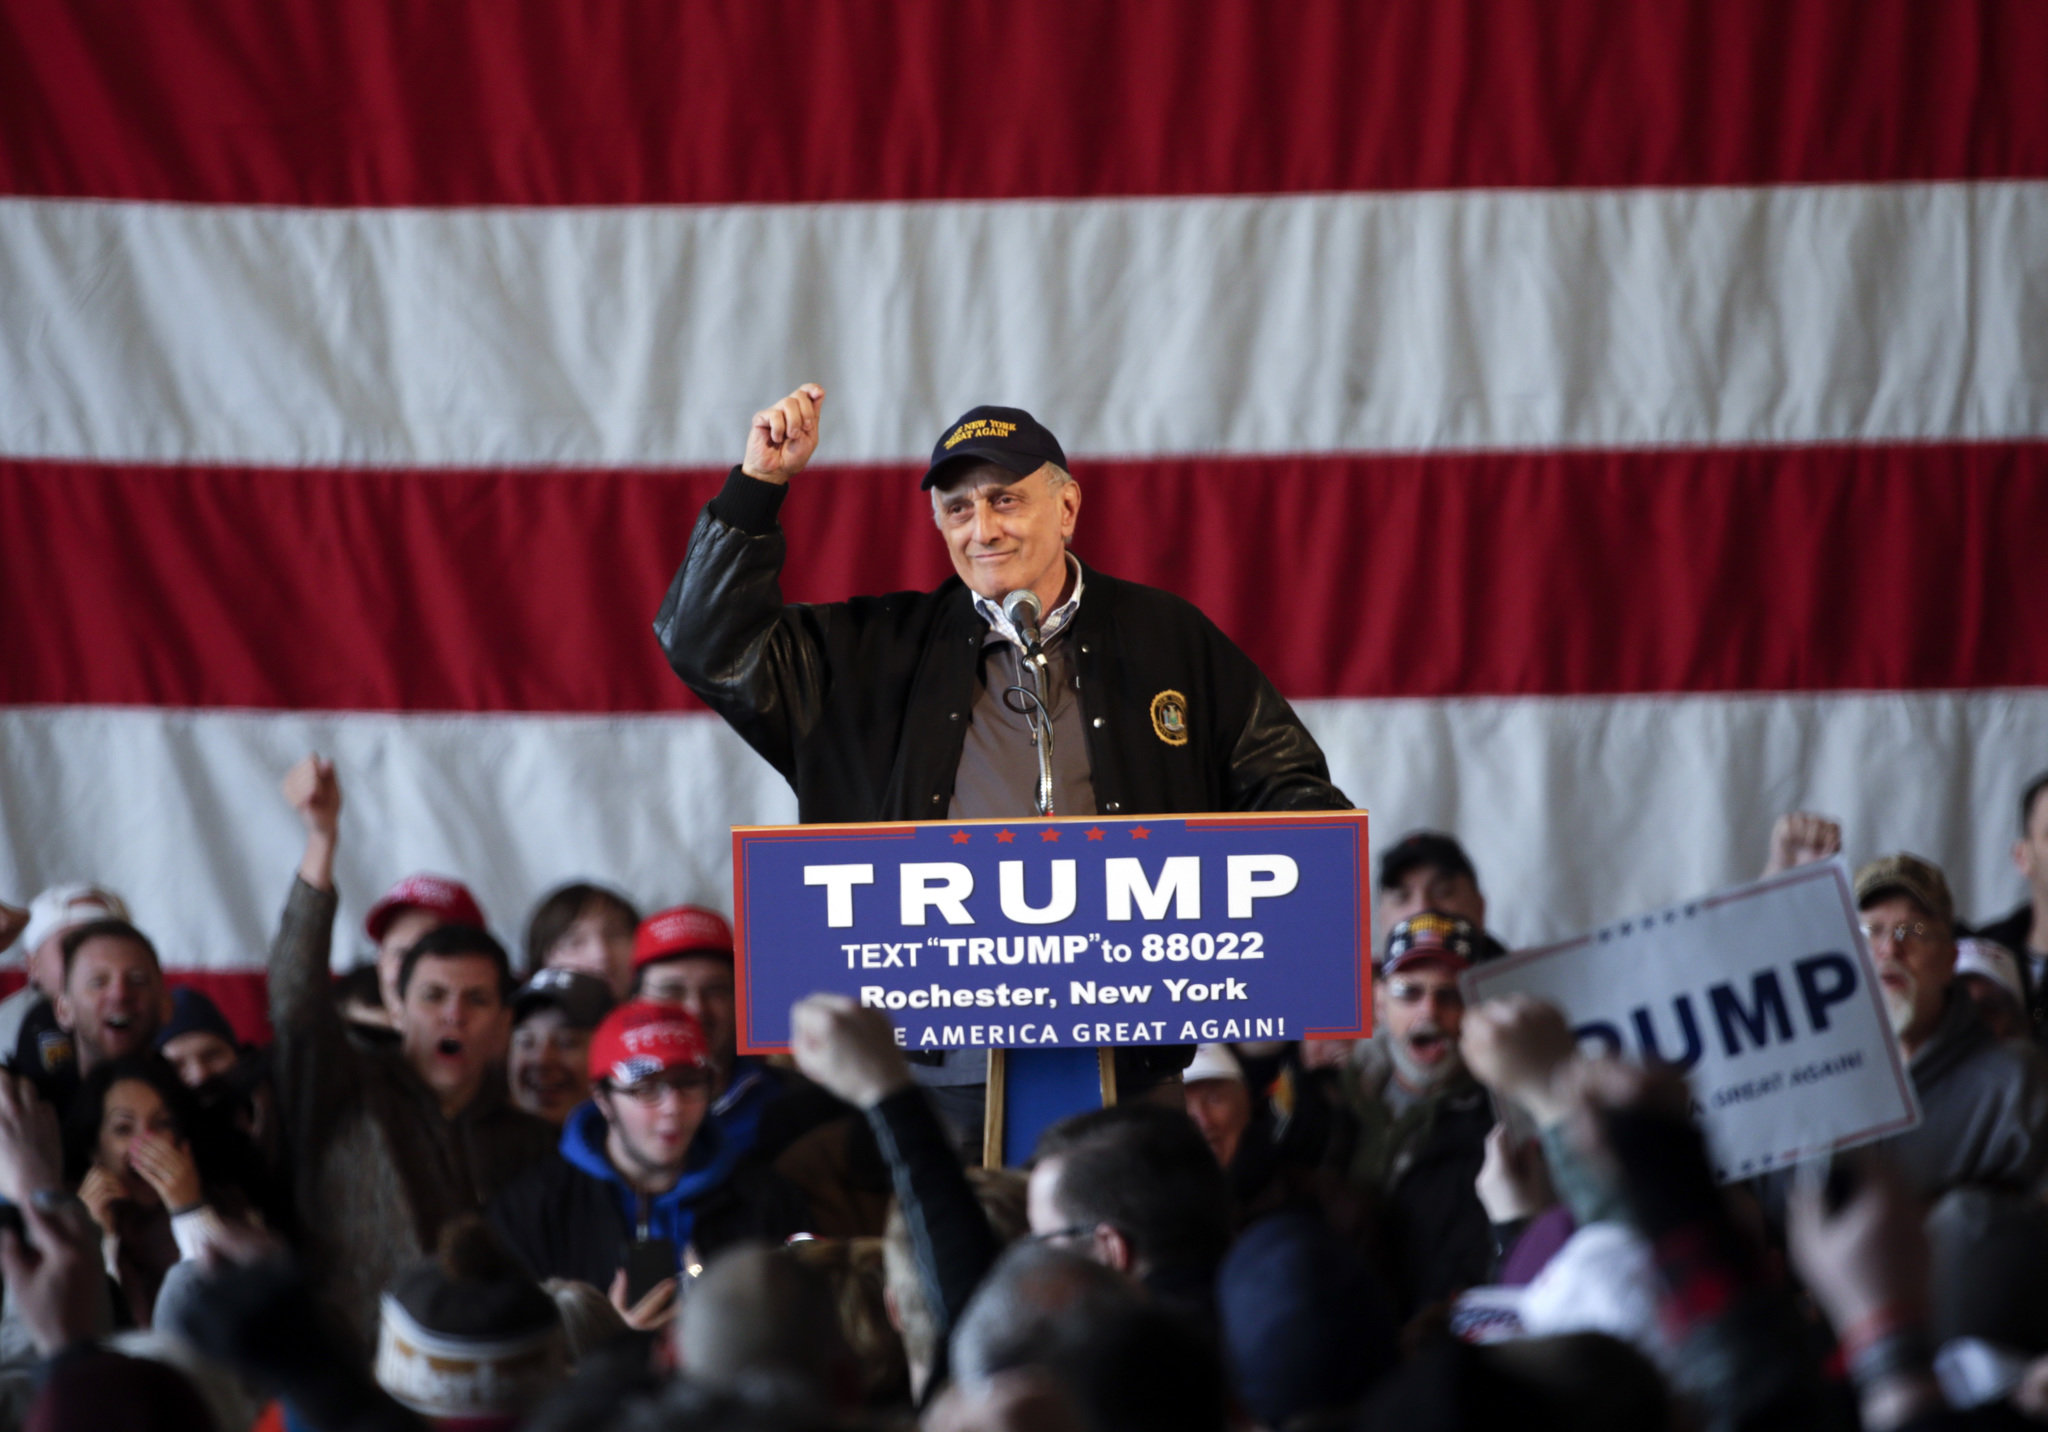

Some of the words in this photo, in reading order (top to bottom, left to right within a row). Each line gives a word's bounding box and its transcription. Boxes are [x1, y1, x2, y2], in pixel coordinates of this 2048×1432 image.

[964, 419, 987, 431] NEW
[989, 419, 1017, 431] YORK
[975, 427, 1008, 437] AGAIN
[803, 854, 1299, 928] TRUMP
[841, 941, 924, 970] TEXT
[1101, 942, 1132, 964] to
[1142, 932, 1265, 963] 88022
[860, 984, 1058, 1011] Rochester,
[1070, 981, 1153, 1005] New
[1163, 977, 1248, 1002] York
[1572, 951, 1858, 1072] UMP
[920, 1023, 1059, 1046] AMERICA
[1071, 1020, 1167, 1043] GREAT
[1179, 1017, 1285, 1041] AGAIN!
